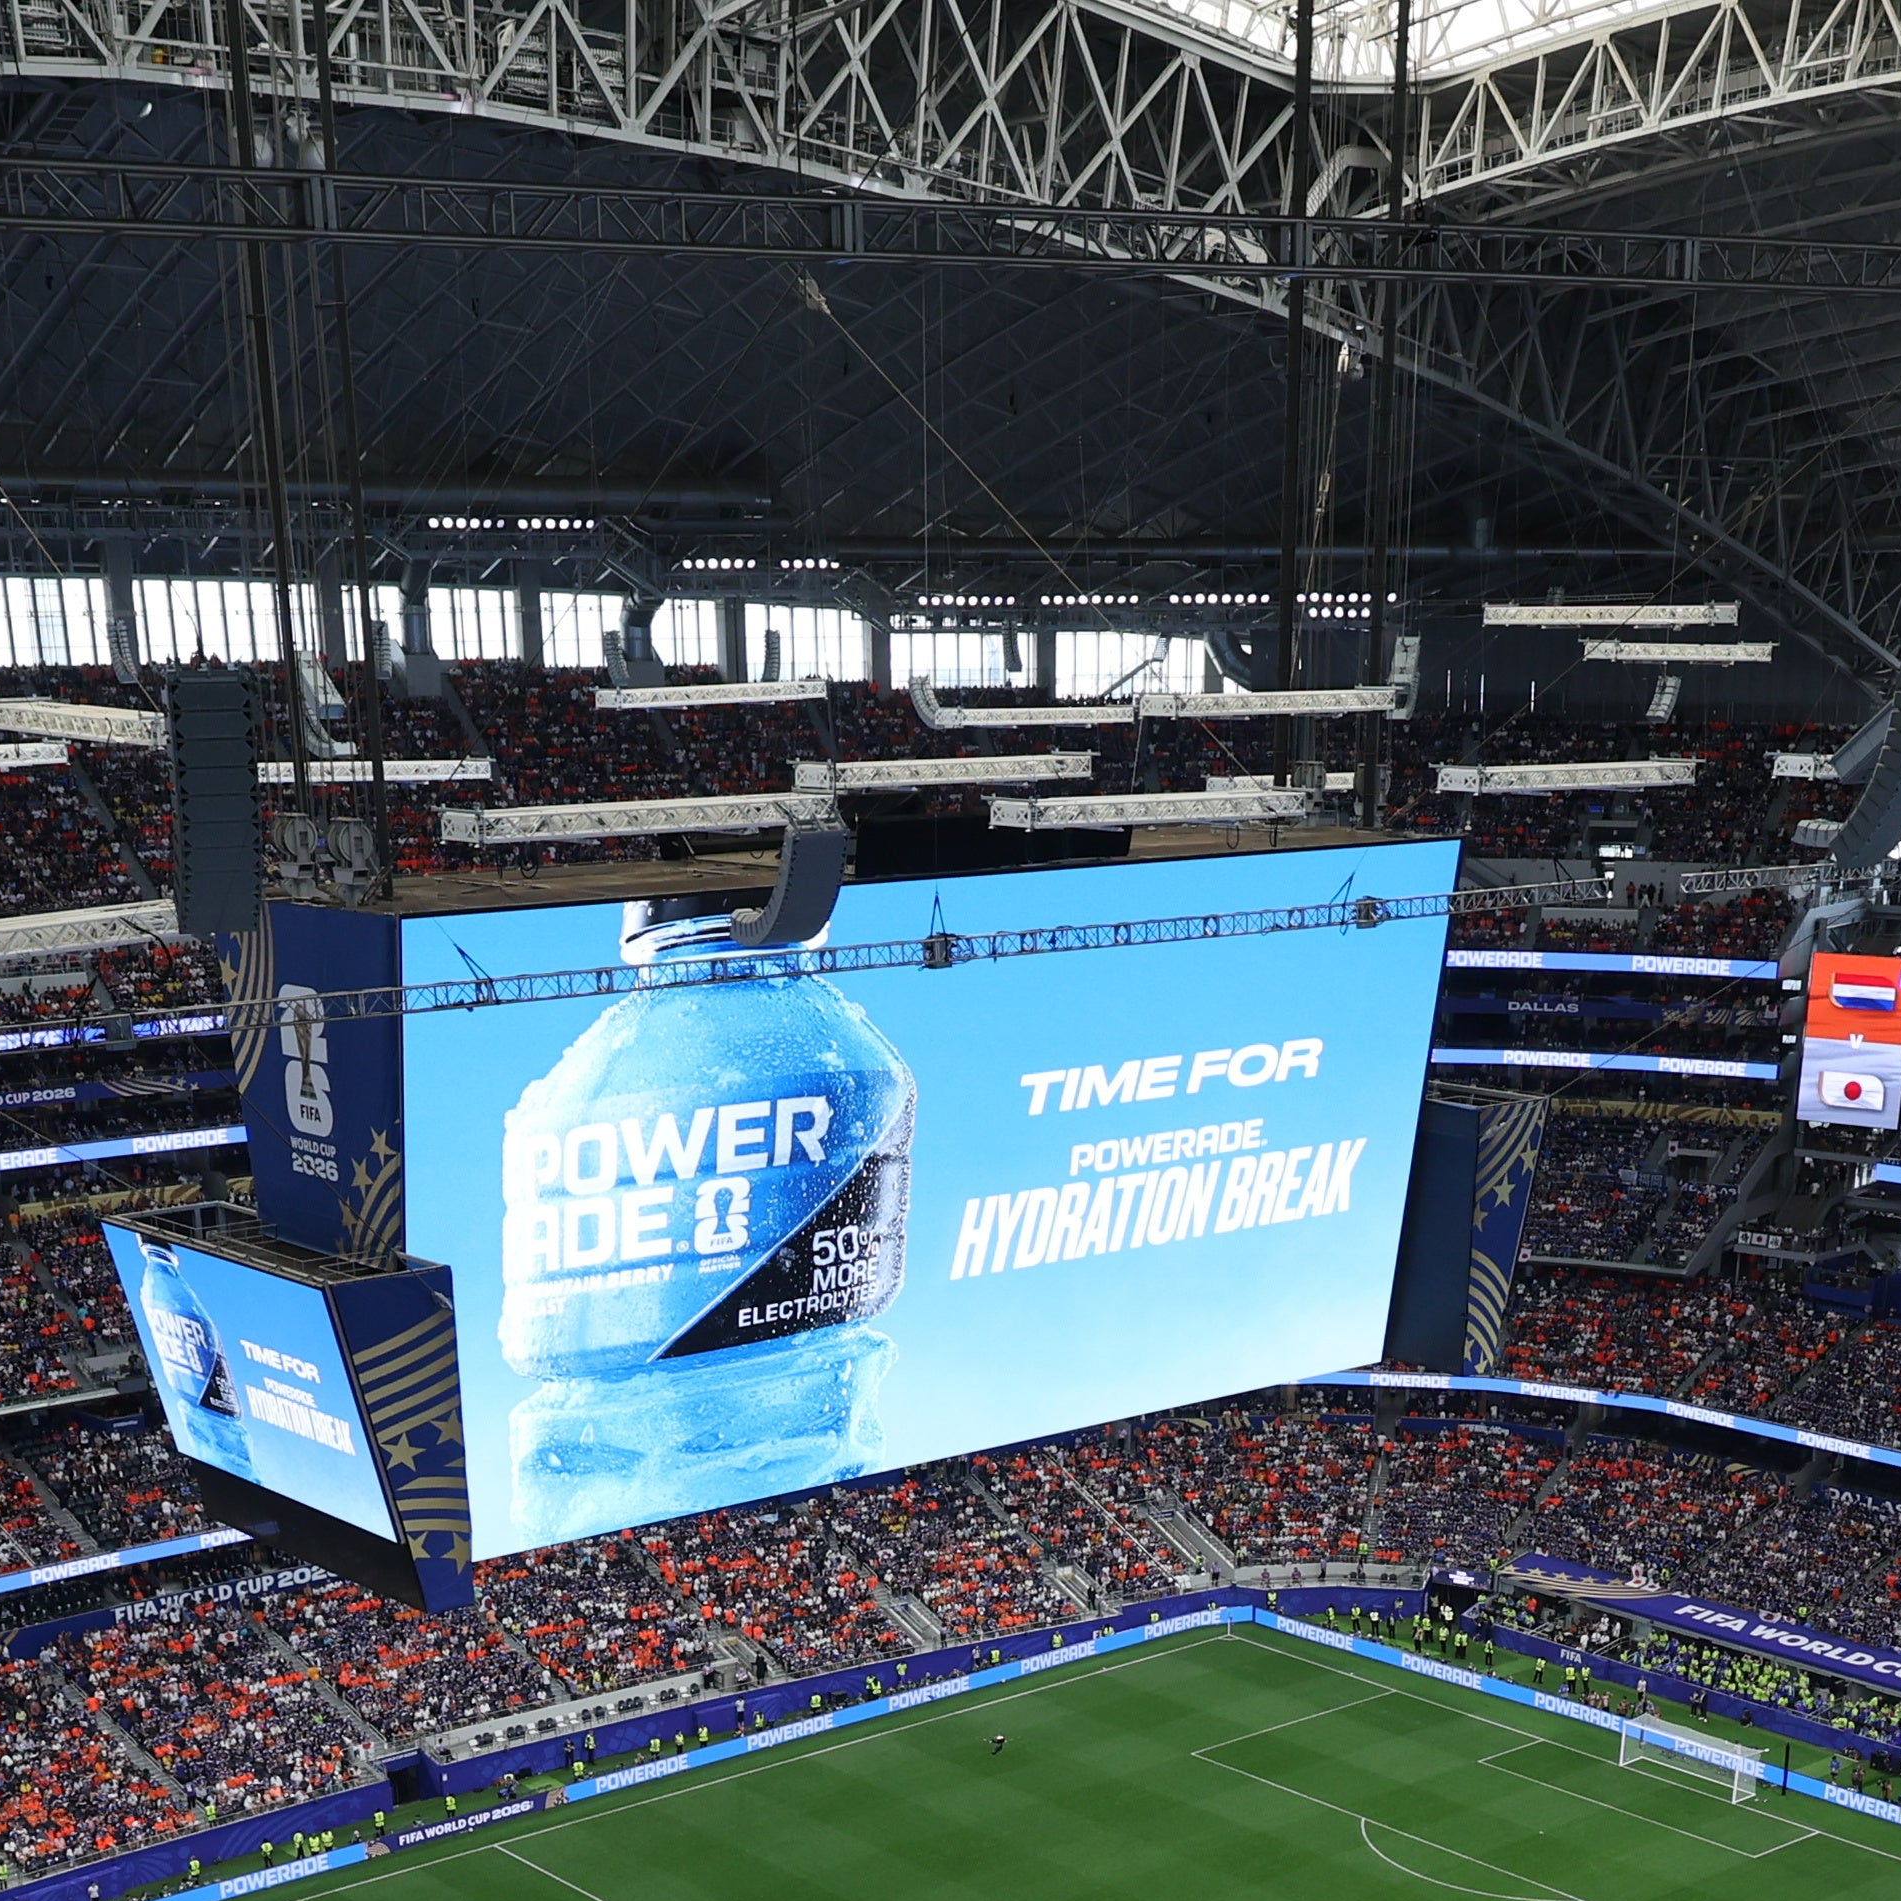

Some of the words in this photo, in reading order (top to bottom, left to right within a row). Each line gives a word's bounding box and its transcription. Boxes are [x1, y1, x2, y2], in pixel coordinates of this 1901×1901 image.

[1632, 956, 1731, 975] POWERADE
[1508, 1001, 1579, 1013] DALLAS
[1503, 1050, 1591, 1067] POWERADE
[1020, 1055, 1182, 1116] TIME
[1186, 1037, 1323, 1094] FOR
[5, 1091, 30, 1106] CUP
[31, 1088, 77, 1102] 2026
[300, 1104, 322, 1123] FIFA
[132, 1129, 229, 1153] POWERADE
[290, 1135, 319, 1156] WORLD
[320, 1143, 336, 1158] CUP
[526, 1096, 835, 1199] POWER
[291, 1152, 339, 1182] 2026
[949, 1160, 1221, 1280] HYDRATION
[1214, 1137, 1367, 1235] BREAK
[525, 1186, 674, 1274] ADE
[710, 1236, 734, 1248] FIFA
[813, 1225, 881, 1266] 50%
[610, 1264, 673, 1287] BERRY
[699, 1254, 742, 1267] OFFICIAL
[699, 1262, 742, 1274] PARTNER
[812, 1260, 878, 1294] MORE
[738, 1285, 878, 1328] ELECTROLYTES
[240, 1340, 283, 1372] TIME
[282, 1351, 321, 1384] FOR
[1521, 1382, 1598, 1403] POWERADE
[1666, 1402, 1734, 1428] POWERADE
[310, 1411, 356, 1456] BREAK
[30, 1552, 121, 1584] POWERADE
[114, 1601, 159, 1623] FIFA
[235, 1574, 275, 1597] CUP
[1278, 1617, 1353, 1650] POWERADE
[1673, 1604, 1748, 1632] FIFA
[1749, 1624, 1875, 1666] WORLD
[1403, 1654, 1481, 1689] POWERADE
[1560, 1648, 1582, 1664] FIFA
[890, 1676, 968, 1710] POWERADE
[1535, 1692, 1620, 1733] POWERADE
[399, 1831, 424, 1846] FIFA
[425, 1819, 467, 1840] WORLD
[468, 1812, 490, 1827] CUP
[491, 1801, 531, 1820] 2026
[221, 1854, 328, 1896] POWERADE
